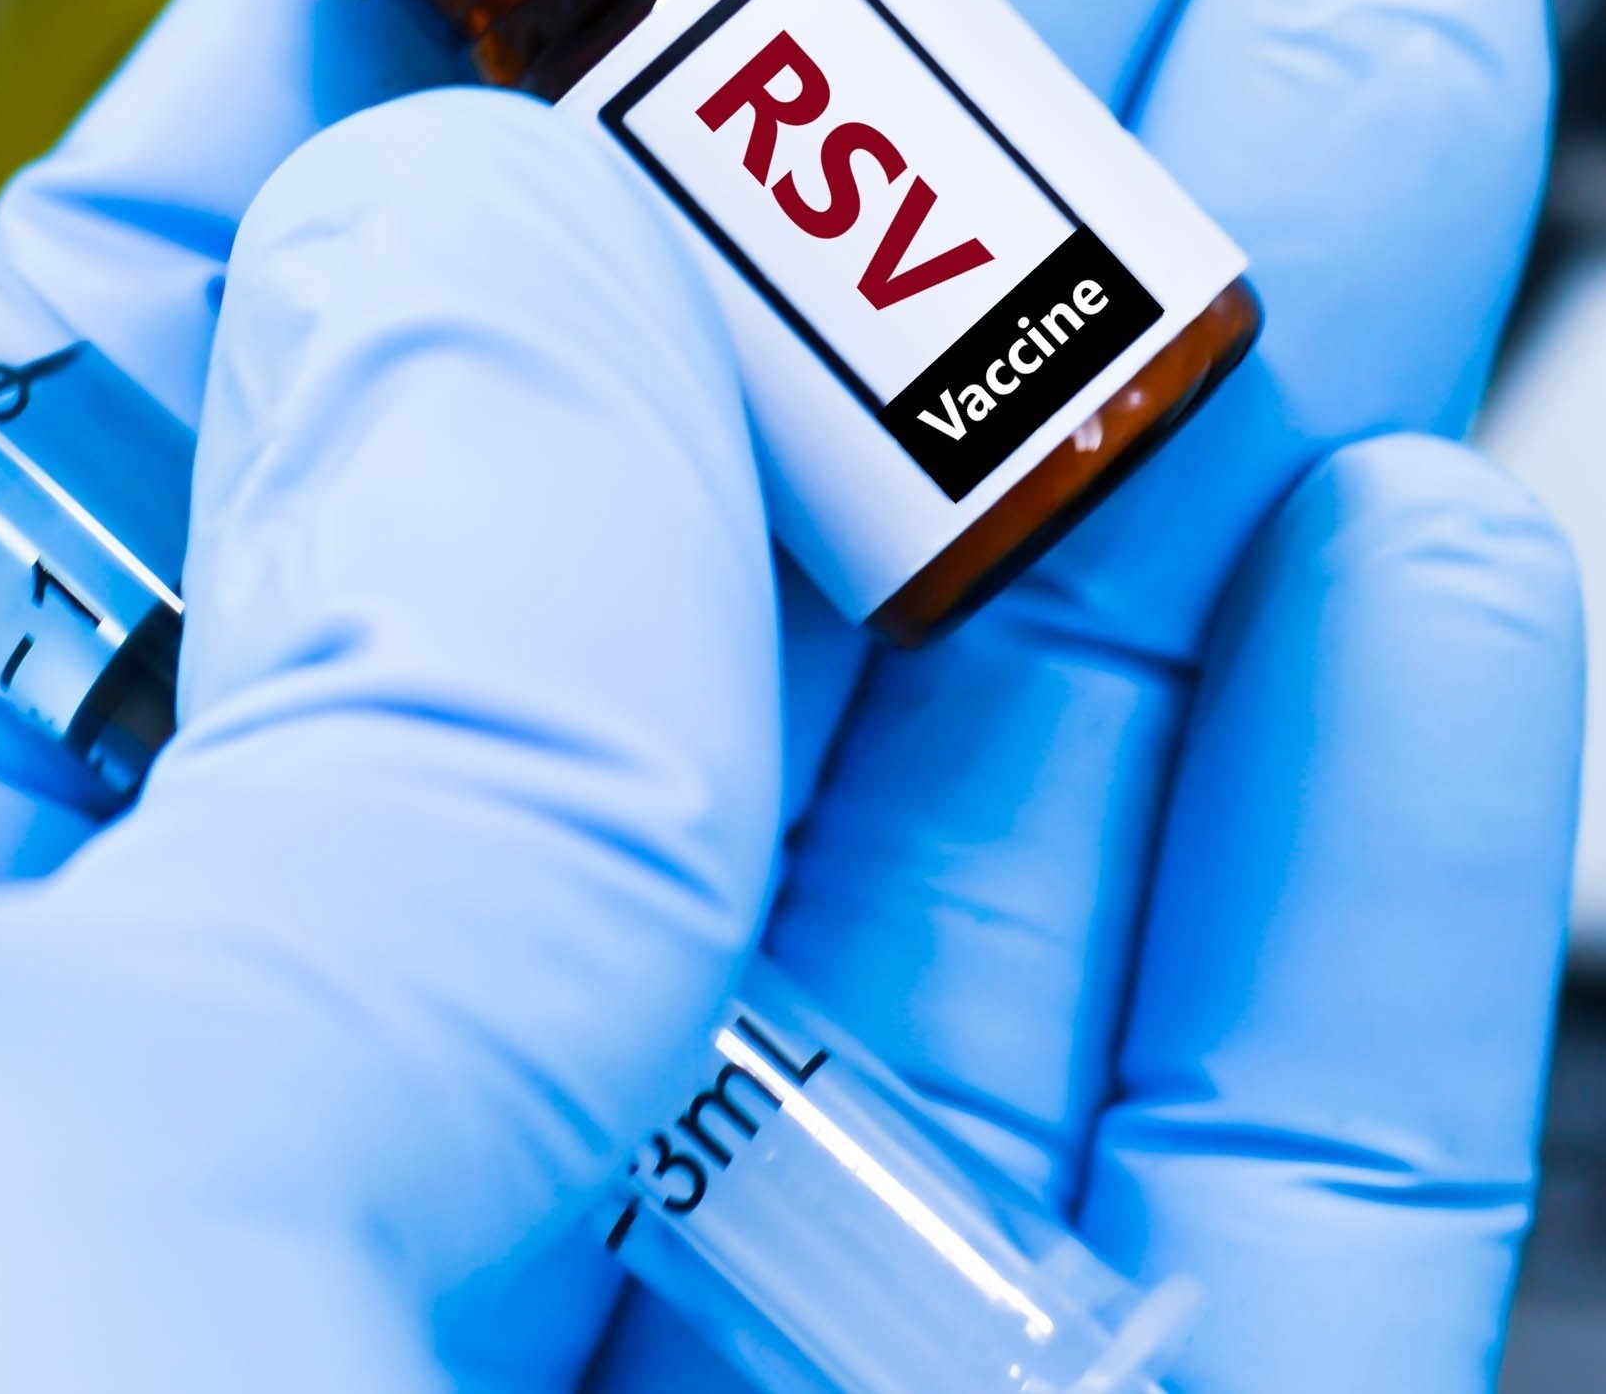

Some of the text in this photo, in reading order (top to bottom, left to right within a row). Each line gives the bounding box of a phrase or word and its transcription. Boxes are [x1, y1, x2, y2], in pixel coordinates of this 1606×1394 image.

[694, 29, 996, 311] RSV
[916, 277, 1110, 442] Vaccine
[31, 556, 106, 629] 1
[628, 1015, 830, 1218] 3mL
